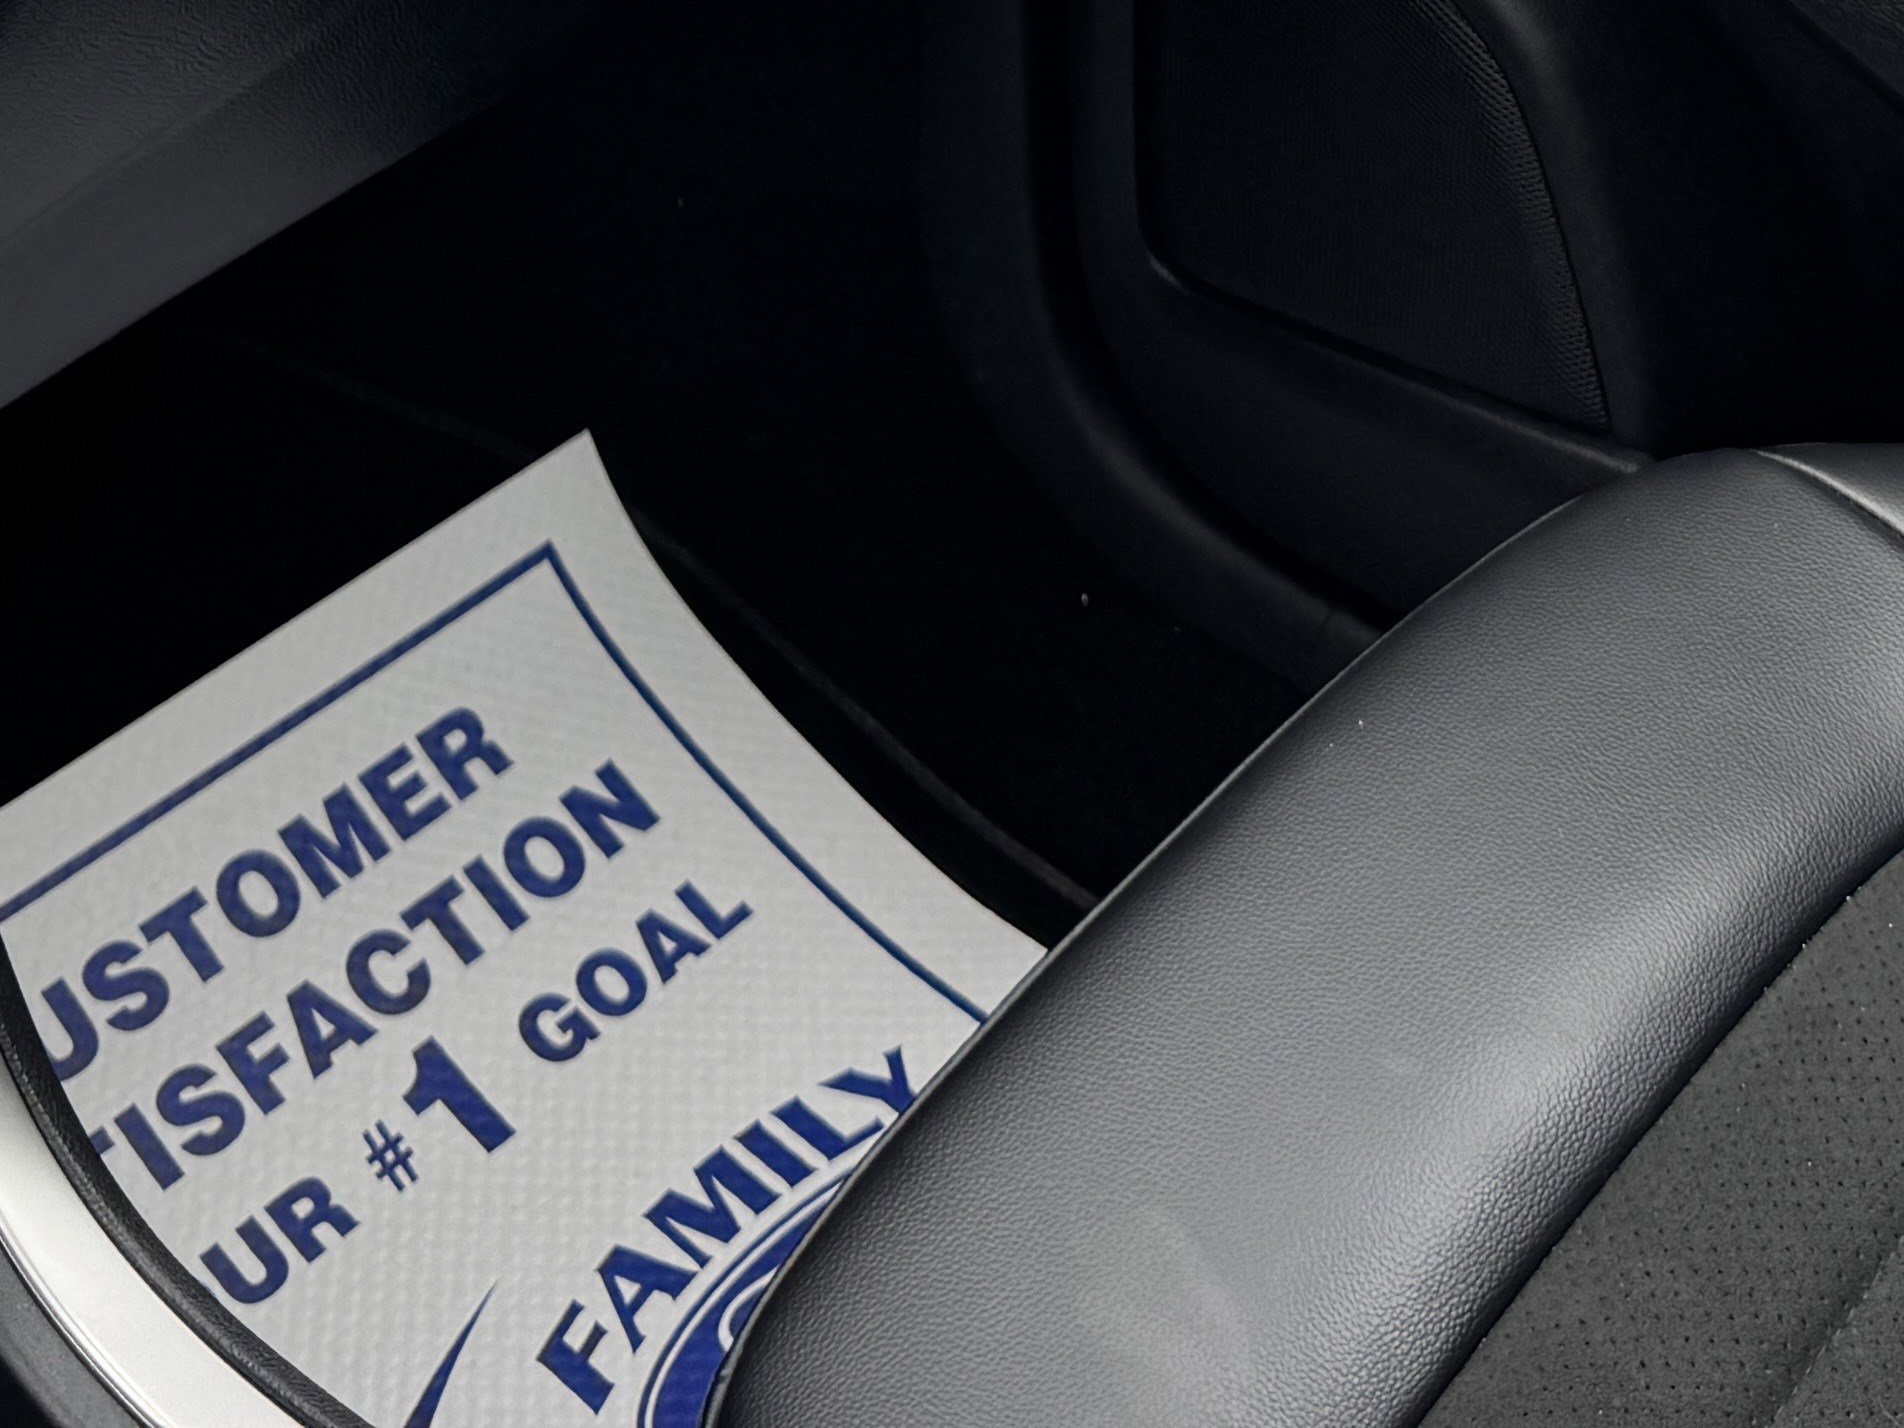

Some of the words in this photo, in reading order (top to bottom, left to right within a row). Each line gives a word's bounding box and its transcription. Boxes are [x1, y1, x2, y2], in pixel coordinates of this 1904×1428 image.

[90, 757, 662, 1192] ISFACTION
[517, 876, 755, 1063] GOAL
[536, 1045, 920, 1414] FAMILY
